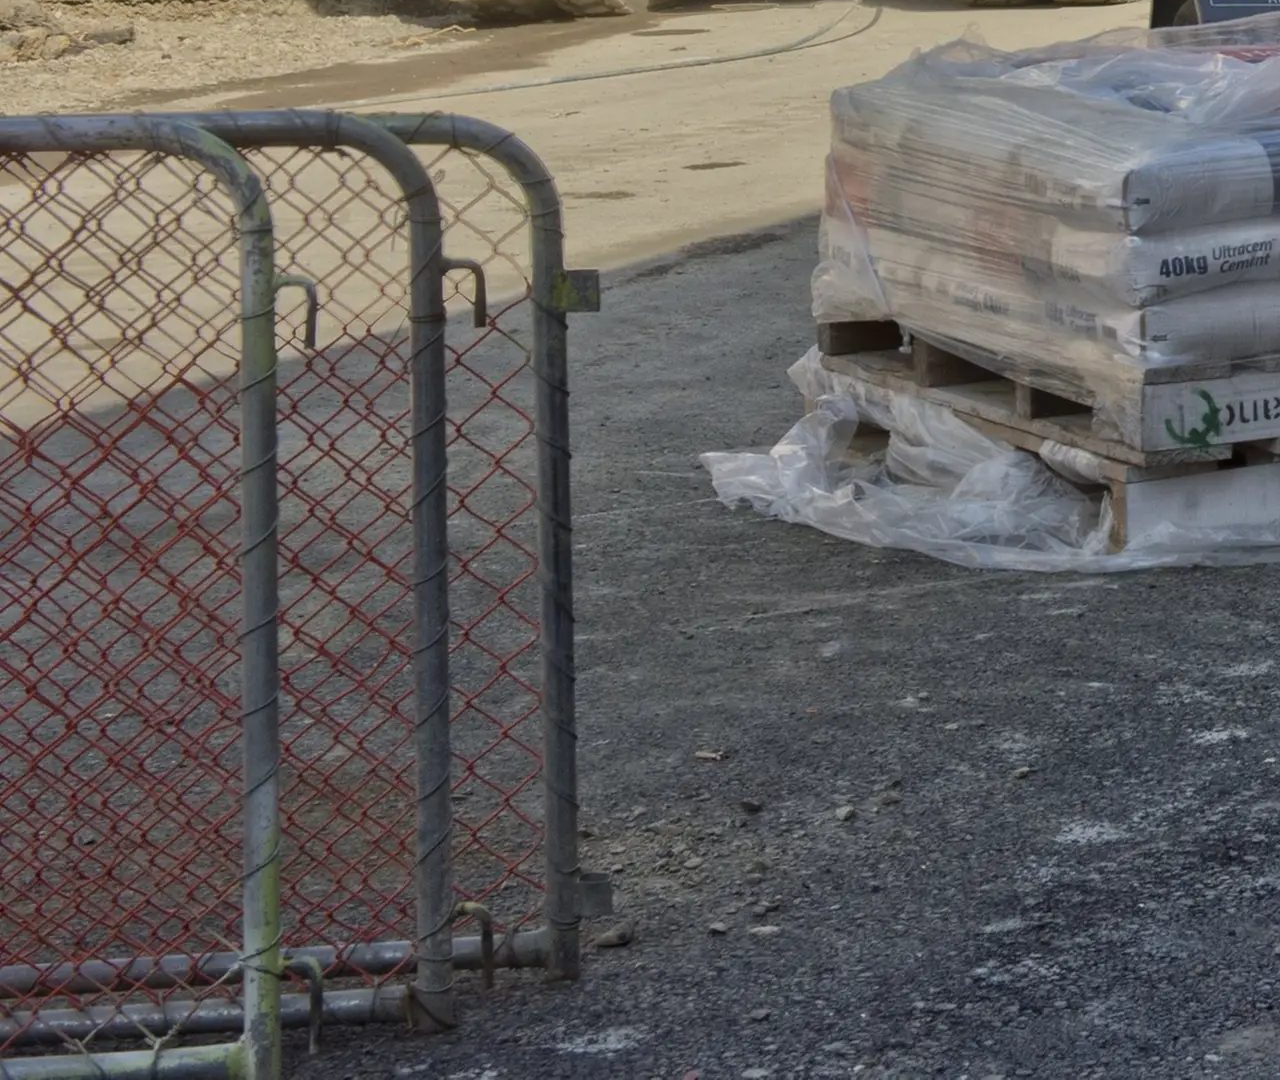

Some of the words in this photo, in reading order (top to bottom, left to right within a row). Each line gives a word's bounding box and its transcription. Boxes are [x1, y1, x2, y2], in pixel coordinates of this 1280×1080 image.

[1159, 255, 1208, 279] 40kg
[1212, 239, 1273, 261] Ultracem
[1219, 253, 1271, 273] Cement
